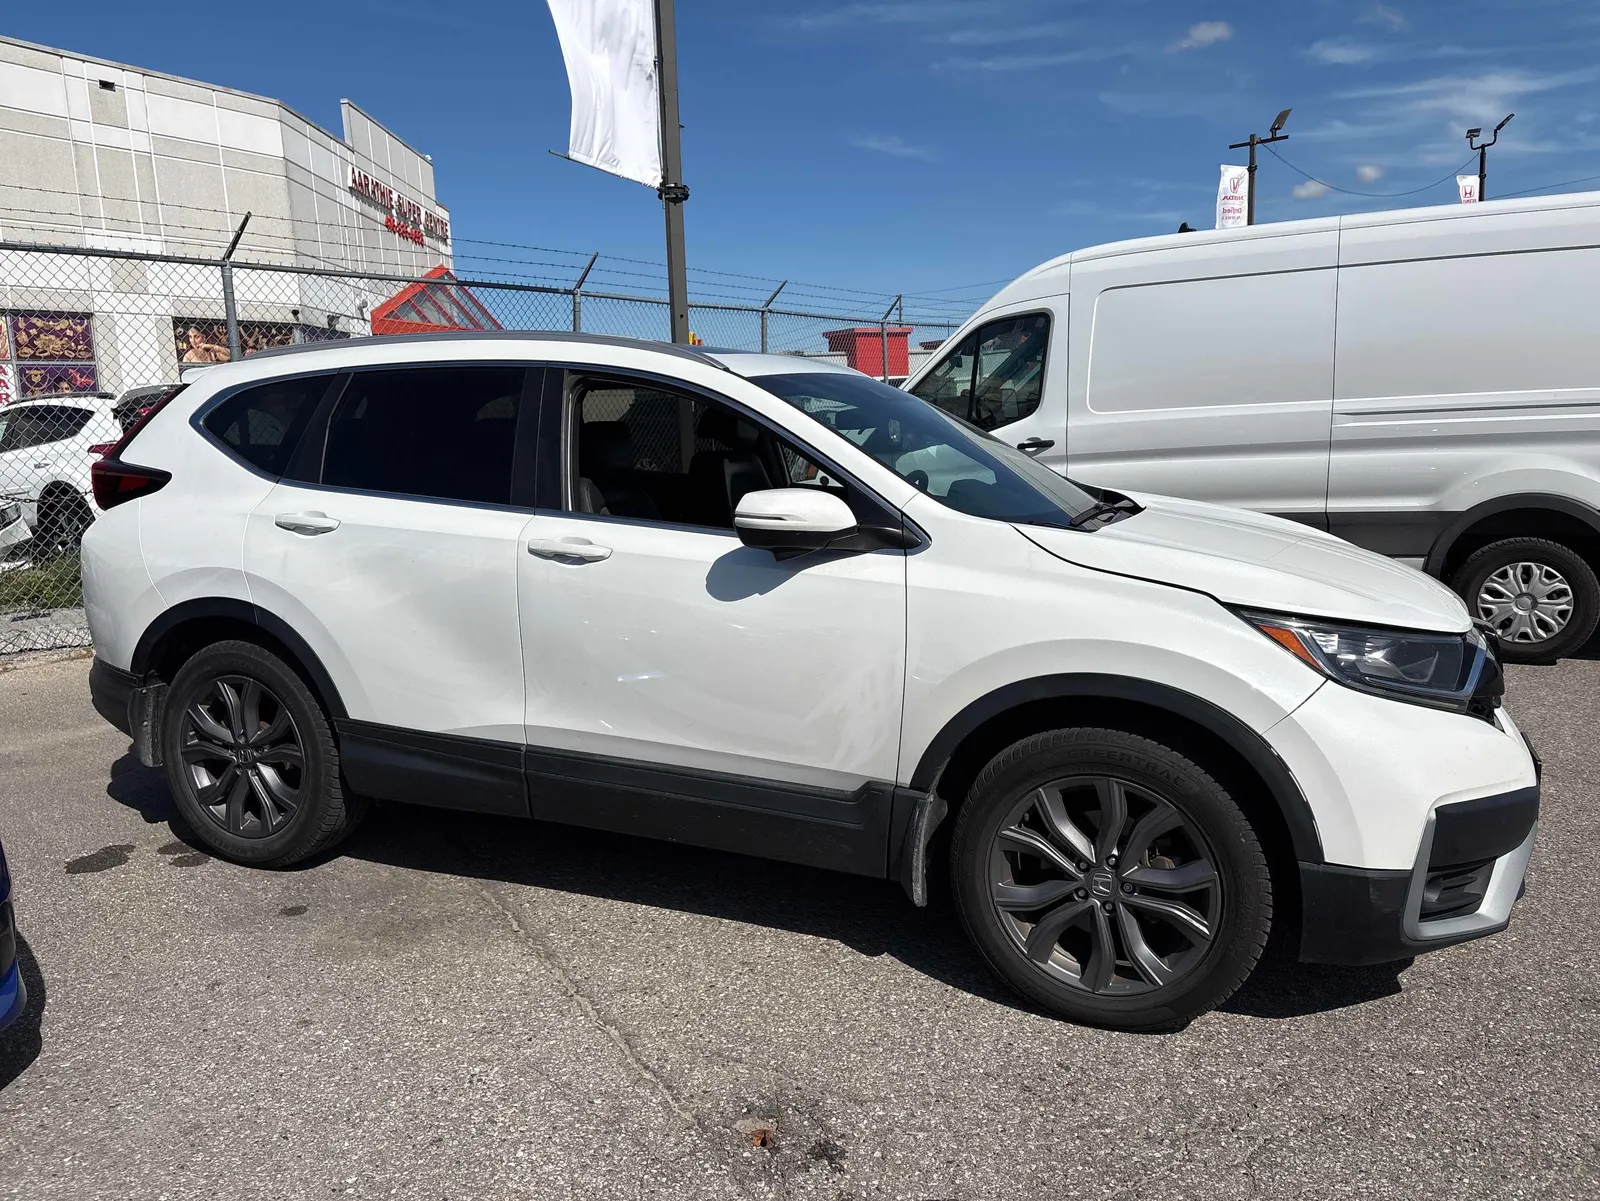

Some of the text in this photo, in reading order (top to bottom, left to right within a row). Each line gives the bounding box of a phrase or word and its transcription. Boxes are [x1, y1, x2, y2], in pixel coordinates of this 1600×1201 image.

[351, 166, 395, 210] AARATHIE
[397, 194, 422, 227] SUPER
[424, 211, 449, 240] CENTRE
